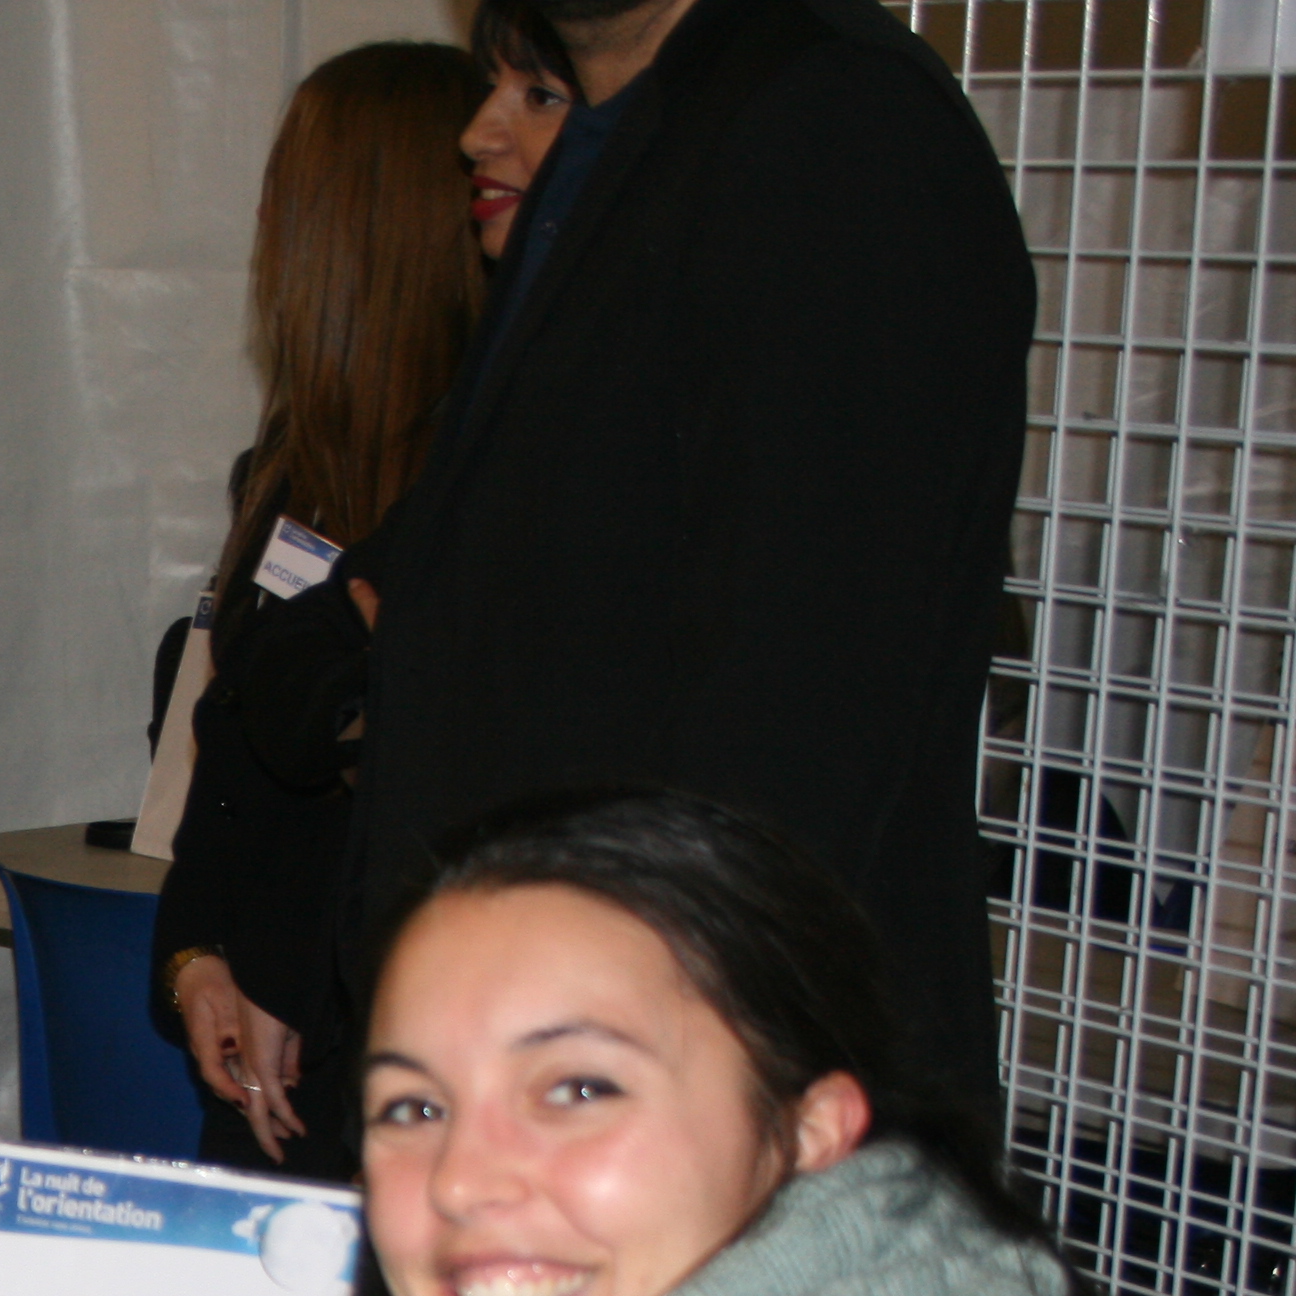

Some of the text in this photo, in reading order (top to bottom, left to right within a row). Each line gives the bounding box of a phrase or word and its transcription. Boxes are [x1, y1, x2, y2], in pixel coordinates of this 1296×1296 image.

[20, 1166, 107, 1198] La nuit de
[16, 1186, 165, 1231] l'orientation
